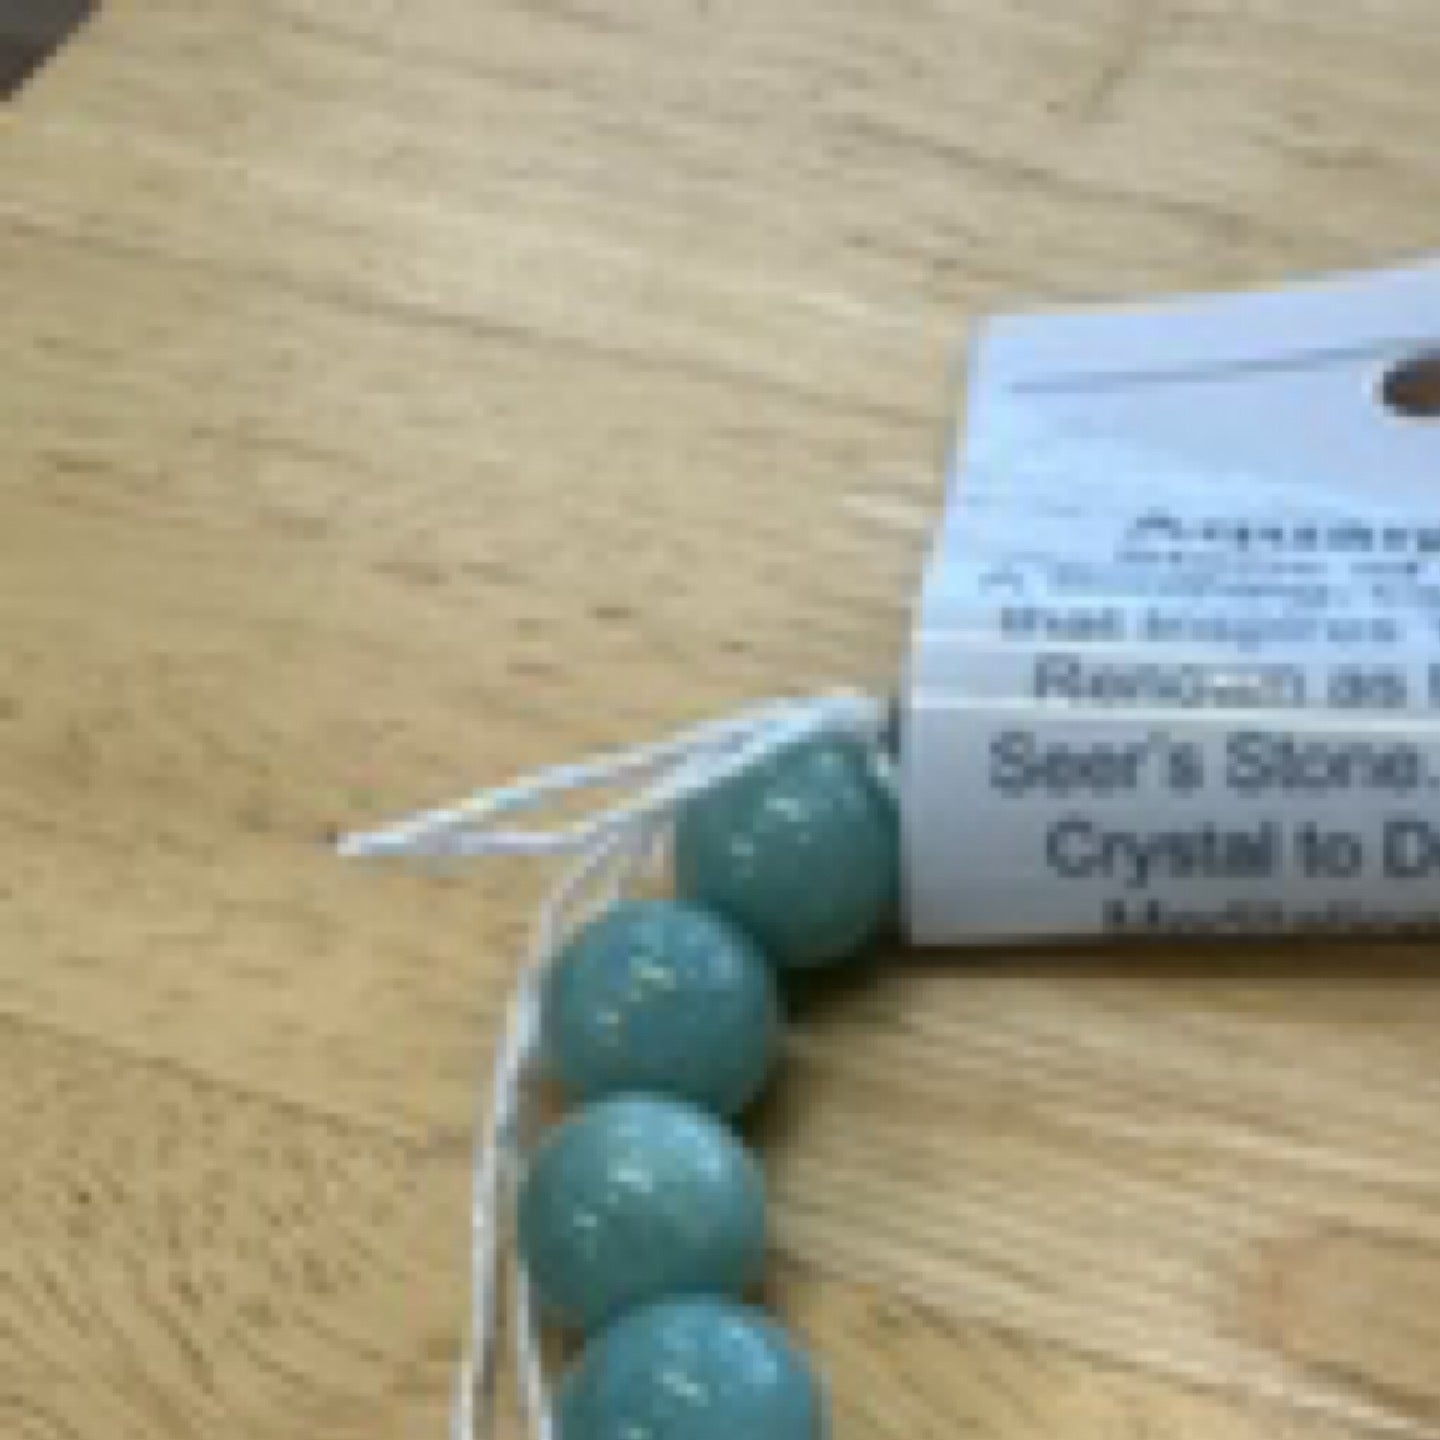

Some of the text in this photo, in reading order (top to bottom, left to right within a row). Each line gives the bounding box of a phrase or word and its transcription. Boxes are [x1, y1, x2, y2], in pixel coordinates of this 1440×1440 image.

[1328, 662, 1408, 708] as
[990, 730, 1203, 797] Seer's
[1045, 818, 1282, 890] Crystal
[1298, 820, 1363, 880] to
